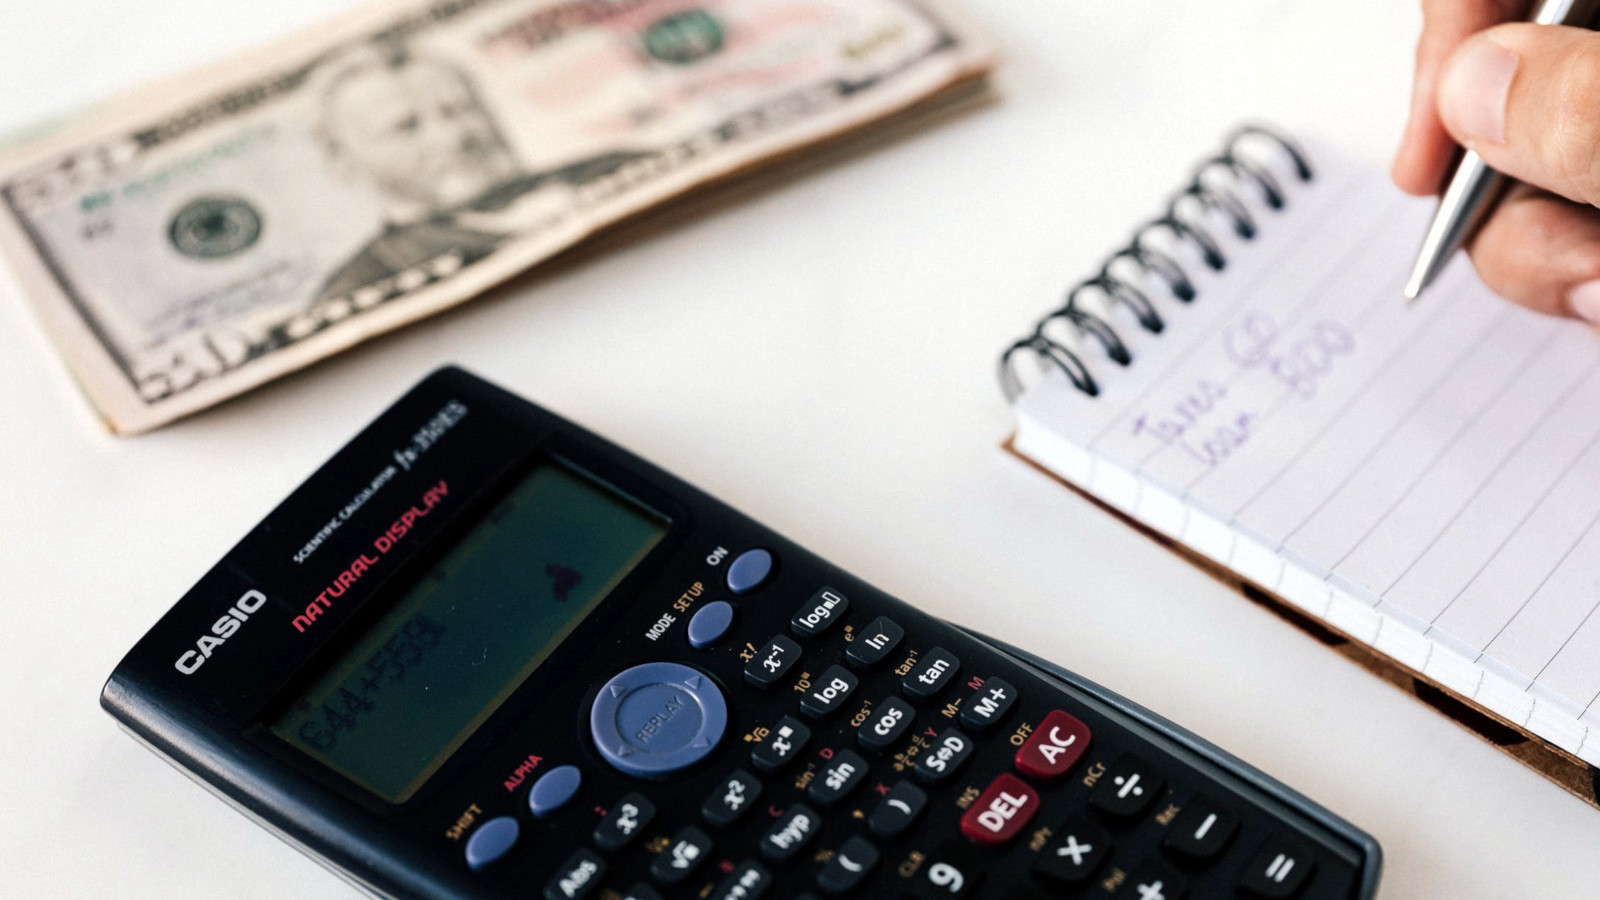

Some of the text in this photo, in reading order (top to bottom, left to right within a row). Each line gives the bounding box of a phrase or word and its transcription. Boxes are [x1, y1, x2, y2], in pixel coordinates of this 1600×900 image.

[291, 480, 449, 632] NATURAL DISPLAY
[706, 546, 729, 566] ON
[174, 589, 267, 675] CASIO
[645, 612, 676, 641] MODE
[865, 632, 890, 650] ln
[918, 659, 950, 685] tan
[967, 675, 985, 691] M
[813, 678, 849, 704] log
[973, 687, 1007, 718] M+
[636, 695, 686, 743] REPLAY
[874, 707, 903, 735] cos
[923, 726, 938, 738] Y
[1009, 722, 1034, 746] OFF
[1038, 726, 1076, 765] AC
[819, 747, 834, 760] D
[504, 753, 543, 792] ALPHA
[825, 762, 855, 790] sin
[1082, 762, 1107, 788] nCr
[874, 782, 890, 796] X
[956, 786, 980, 809] INS
[446, 803, 483, 840] SHIFT
[977, 792, 1028, 832] DEL
[769, 814, 810, 849] hyp
[928, 862, 964, 893] 9
